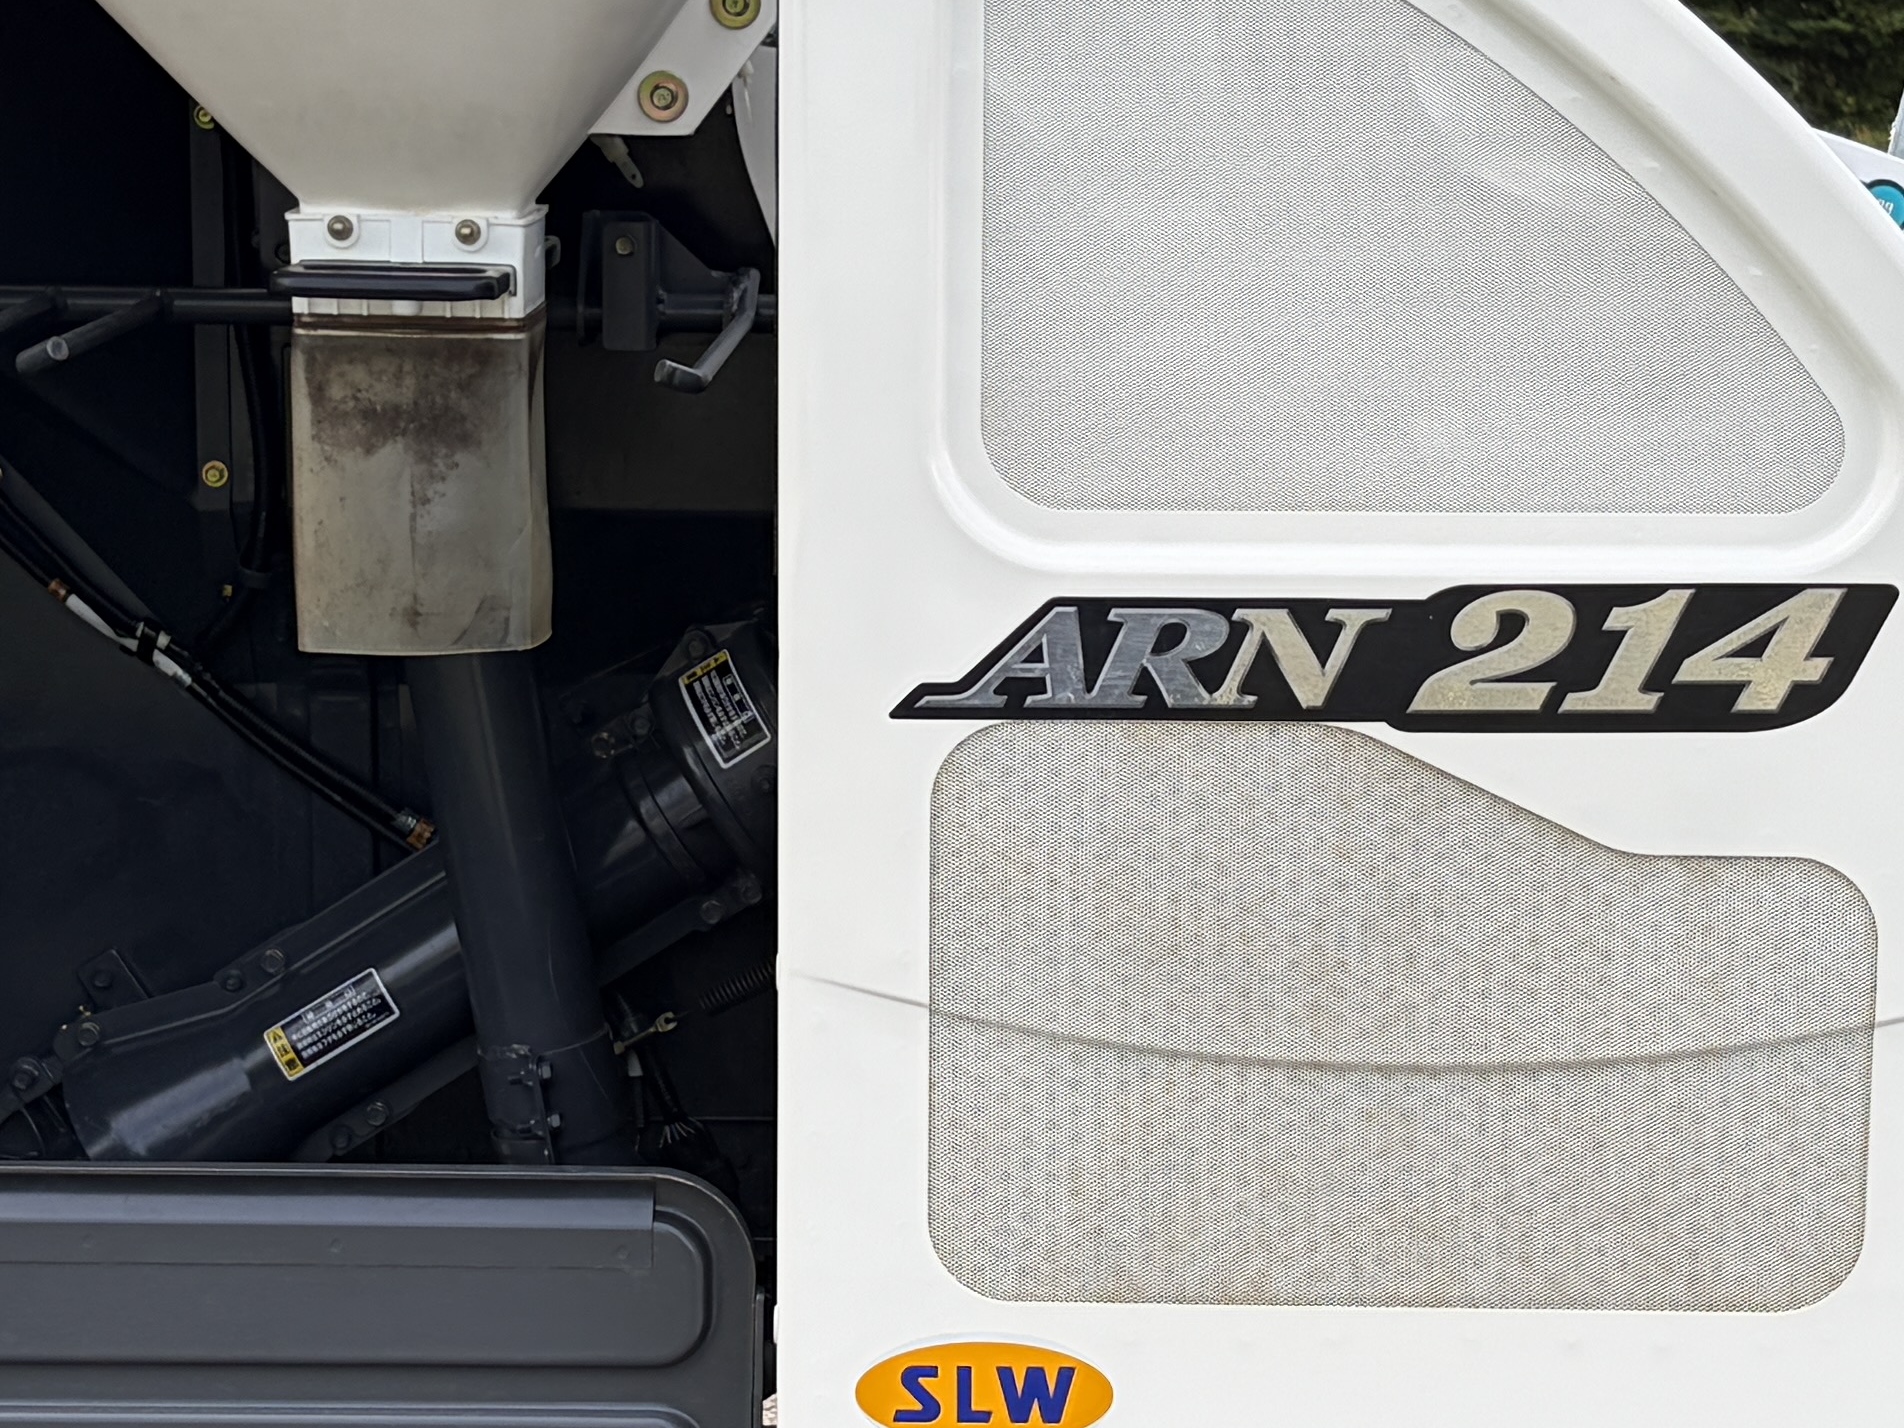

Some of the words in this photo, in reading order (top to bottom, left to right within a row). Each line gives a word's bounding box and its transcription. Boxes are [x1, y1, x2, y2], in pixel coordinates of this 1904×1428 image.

[915, 605, 1393, 711] ARN
[1405, 588, 1835, 715] 214
[892, 1364, 1078, 1425] SLW
